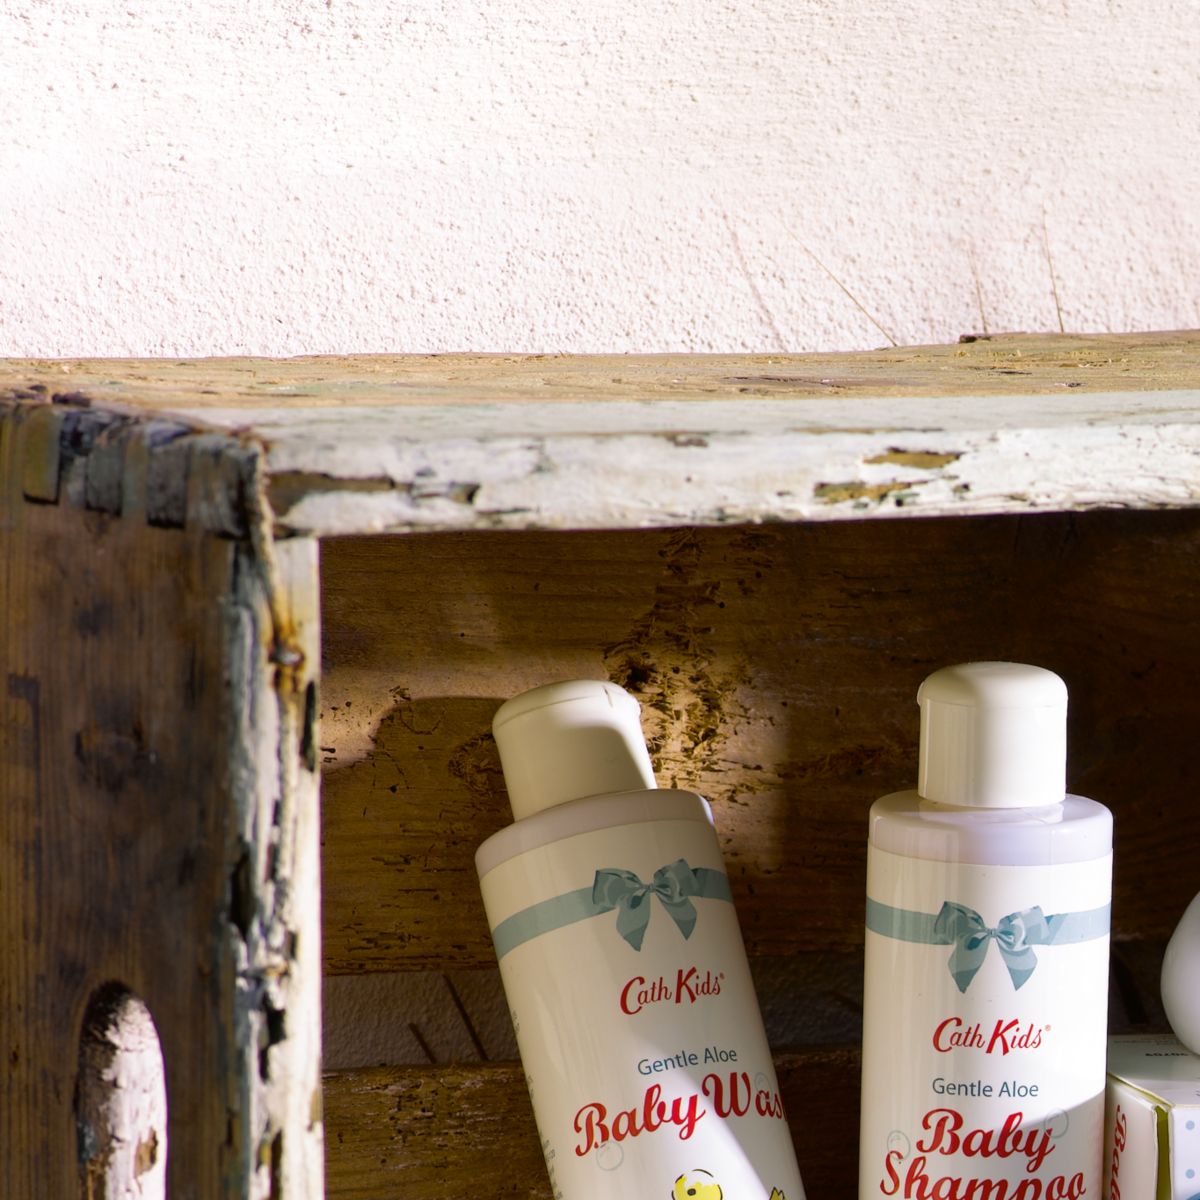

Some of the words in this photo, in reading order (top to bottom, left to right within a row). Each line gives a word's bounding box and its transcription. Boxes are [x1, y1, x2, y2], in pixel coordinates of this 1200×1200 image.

[620, 976, 672, 1015] Cath
[932, 1017, 985, 1053] Cath
[637, 1050, 699, 1075] Gentle
[703, 1046, 738, 1065] Aloe
[932, 1077, 993, 1098] Gentle
[998, 1080, 1039, 1098] Aloe
[574, 1083, 706, 1157] Baby
[701, 1072, 788, 1122] Was
[916, 1108, 1056, 1174] Baby
